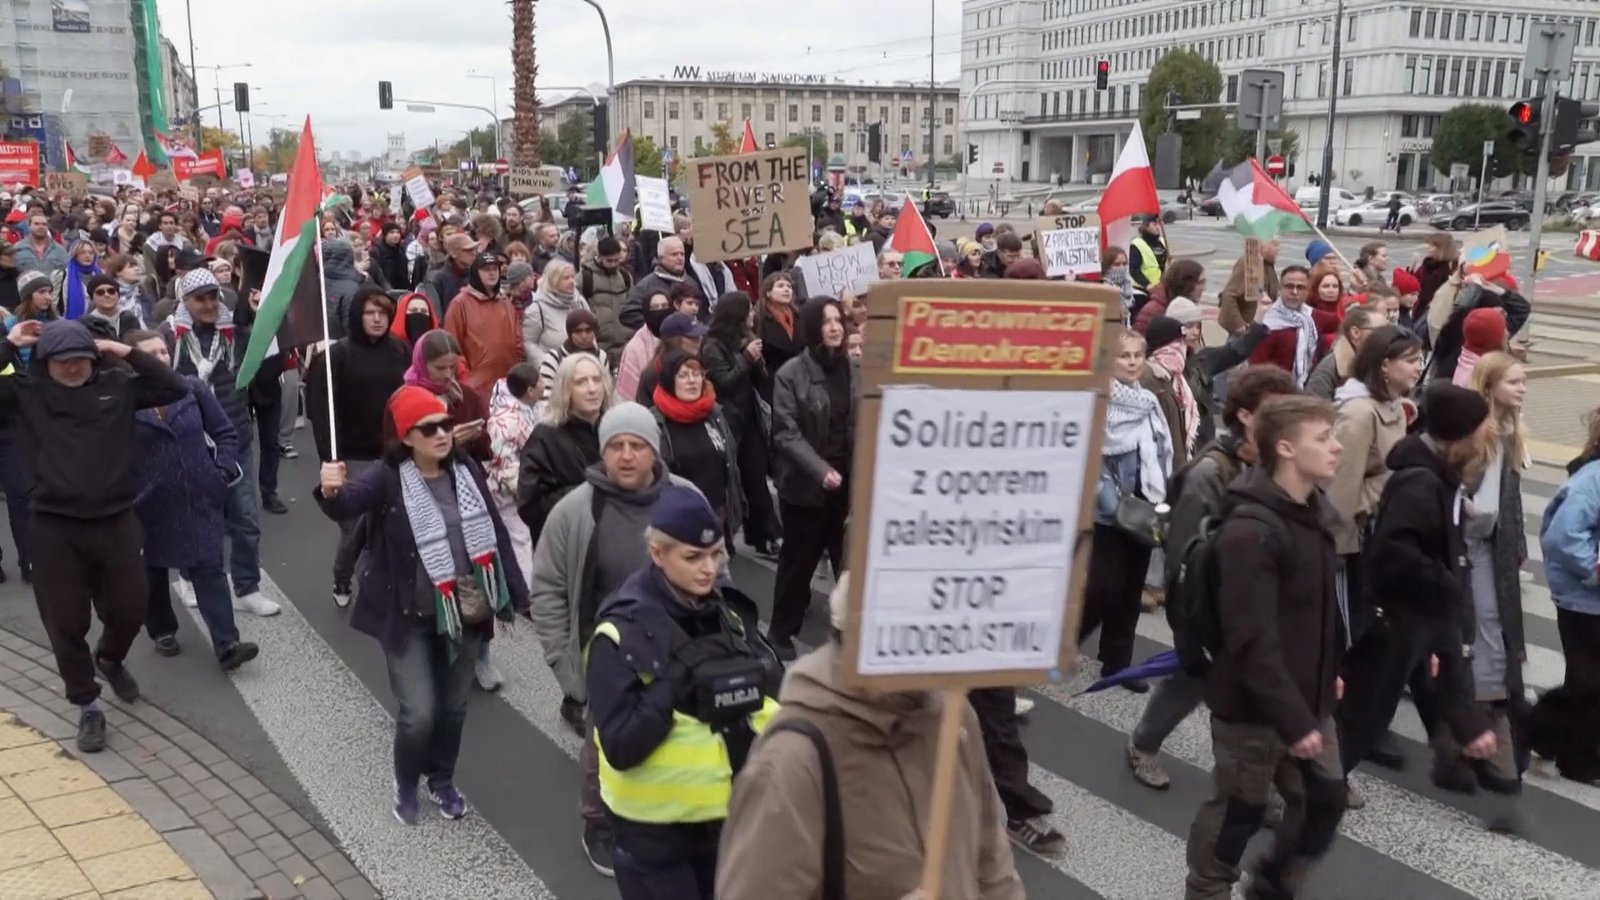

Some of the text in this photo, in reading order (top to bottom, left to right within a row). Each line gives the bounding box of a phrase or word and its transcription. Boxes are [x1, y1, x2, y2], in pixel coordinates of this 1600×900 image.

[706, 71, 826, 84] MUZEUM NARODOWE
[512, 168, 550, 178] KIDS ARE
[512, 176, 554, 189] STARVING
[697, 155, 806, 188] FROM THE
[715, 182, 785, 210] RIVER
[721, 211, 786, 254] SEA
[1055, 215, 1086, 230] STOP
[815, 251, 861, 277] HOW
[907, 302, 1094, 332] Pracownicza
[908, 336, 1086, 369] Demokracja
[890, 408, 1081, 449] Solidarnie
[911, 470, 1048, 504] z oporem
[884, 509, 1062, 556] palestyńskim
[930, 575, 1007, 610] STOP
[875, 617, 1046, 657] LUDOBÓJSTWU
[714, 686, 760, 709] POLICJA
